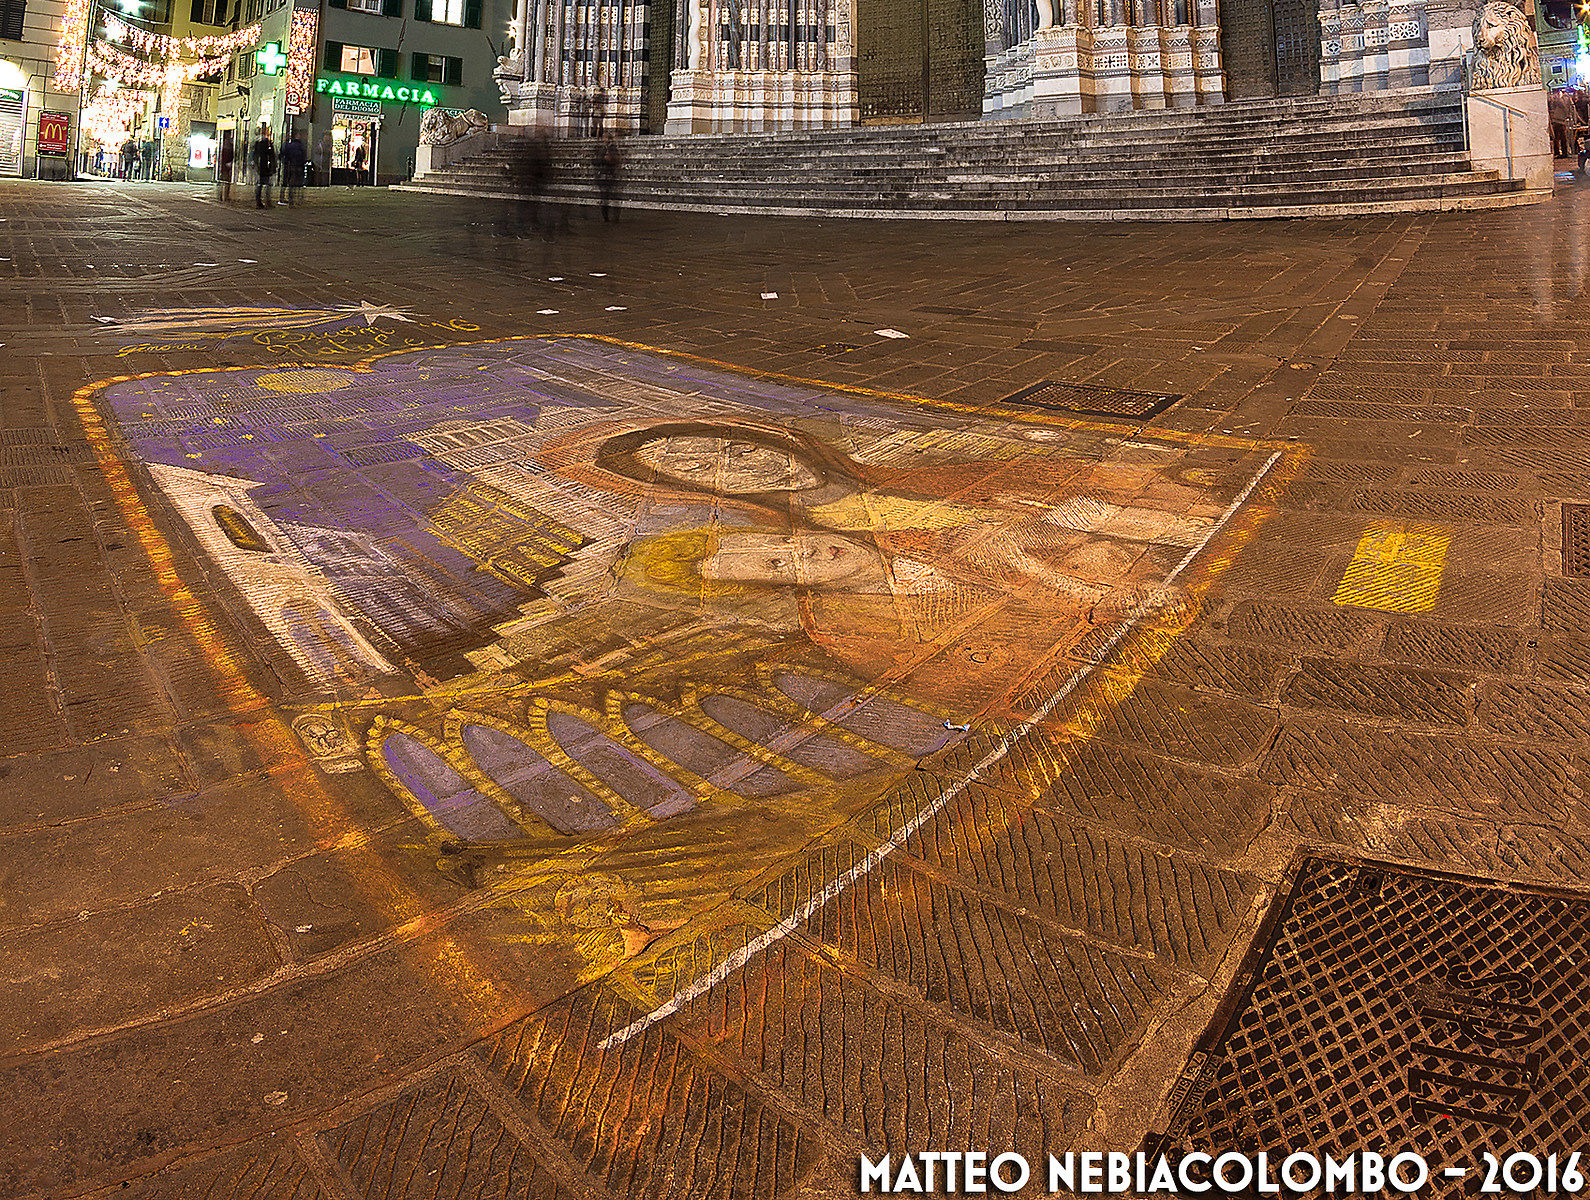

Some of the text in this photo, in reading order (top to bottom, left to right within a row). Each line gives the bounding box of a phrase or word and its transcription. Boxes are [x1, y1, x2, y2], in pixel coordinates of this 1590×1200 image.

[316, 78, 436, 104] FARMACIA
[335, 98, 379, 108] FARMACIA
[351, 105, 380, 113] DUOMO
